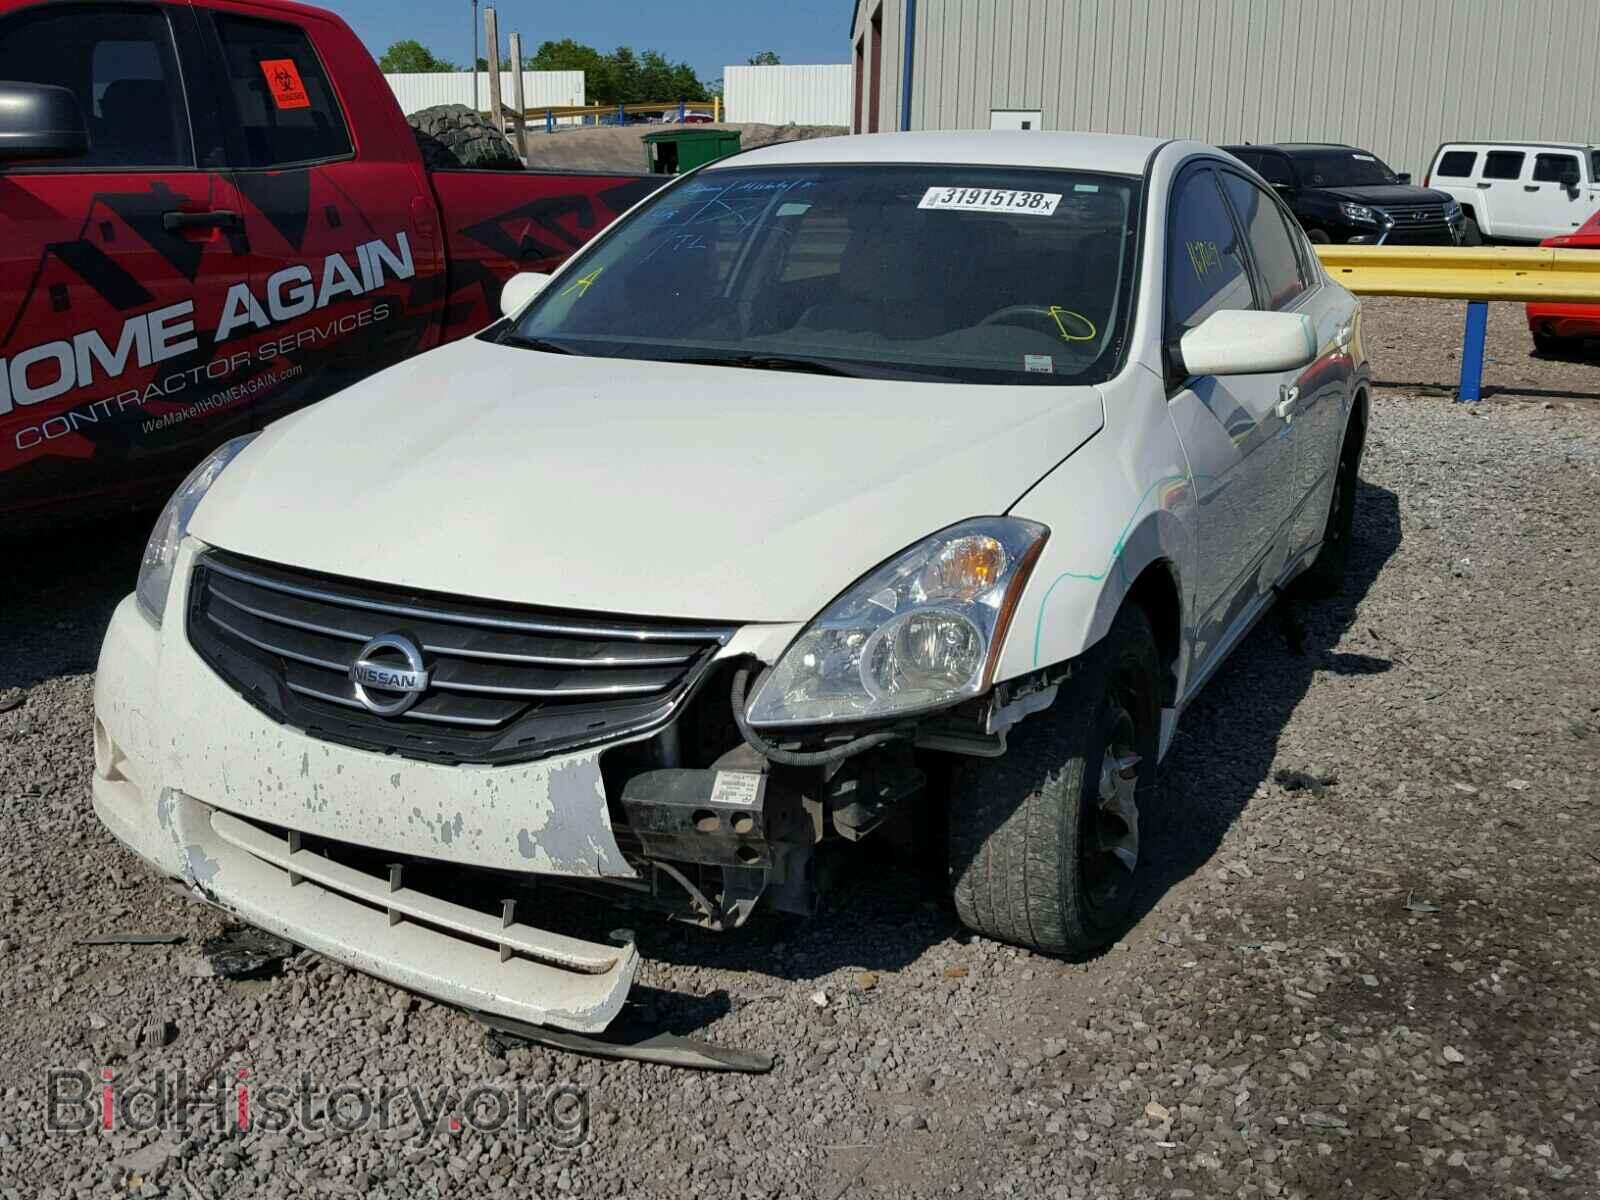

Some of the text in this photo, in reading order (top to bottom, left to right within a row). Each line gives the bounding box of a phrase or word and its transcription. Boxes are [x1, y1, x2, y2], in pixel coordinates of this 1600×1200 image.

[0, 231, 416, 414] OME AGAIN
[15, 303, 391, 450] CONTRACTOR SERVICES
[352, 663, 416, 687] NISSAN
